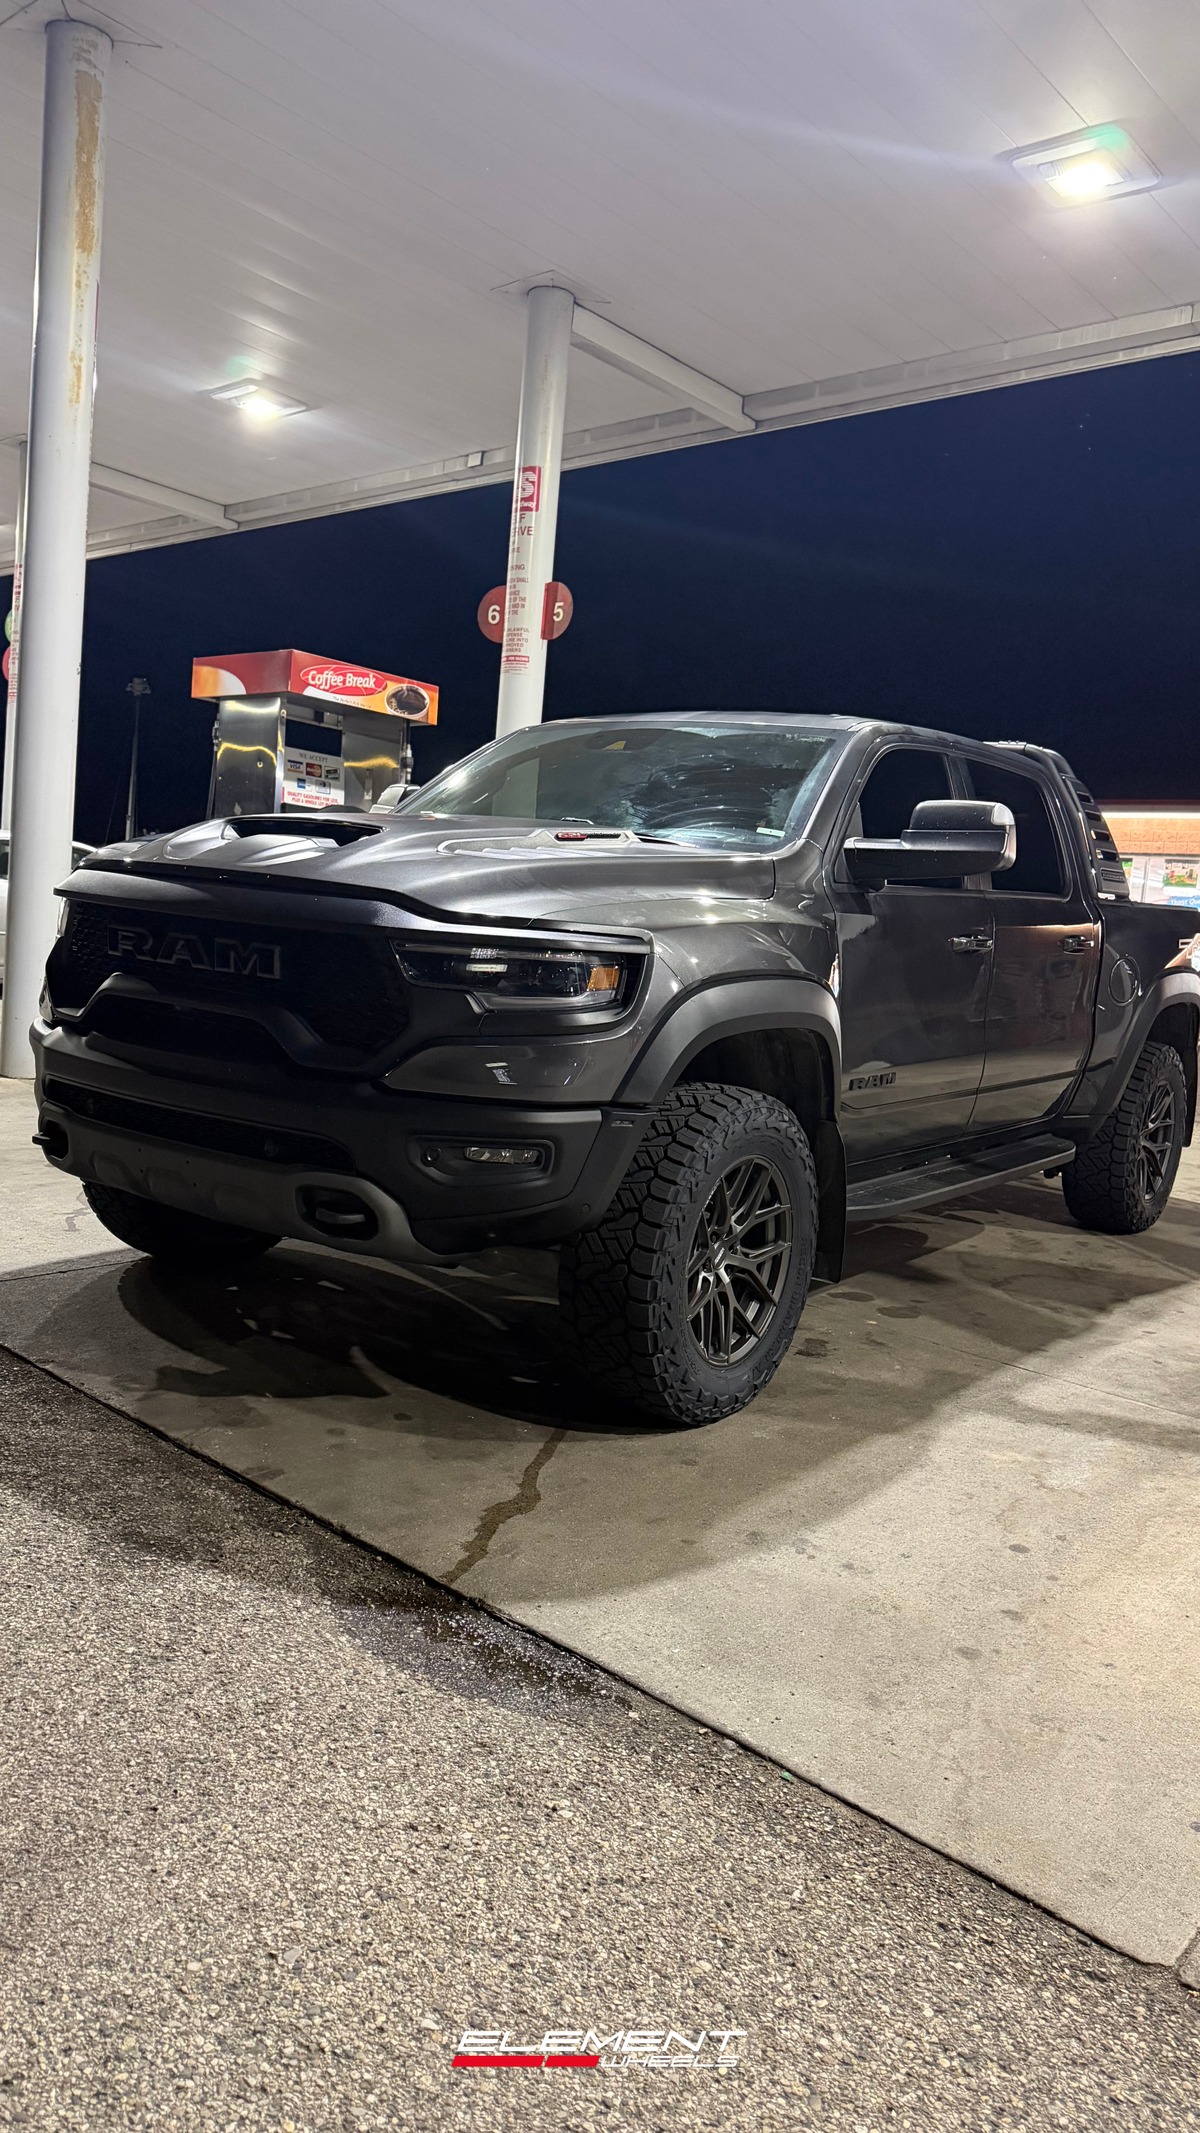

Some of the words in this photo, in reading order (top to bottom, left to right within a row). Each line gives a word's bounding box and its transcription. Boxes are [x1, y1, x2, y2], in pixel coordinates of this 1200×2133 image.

[487, 605, 501, 625] 6
[552, 602, 565, 622] 5
[308, 670, 343, 690] Coffee
[345, 672, 376, 688] Break
[107, 924, 281, 979] RAM
[848, 1072, 896, 1091] RAM
